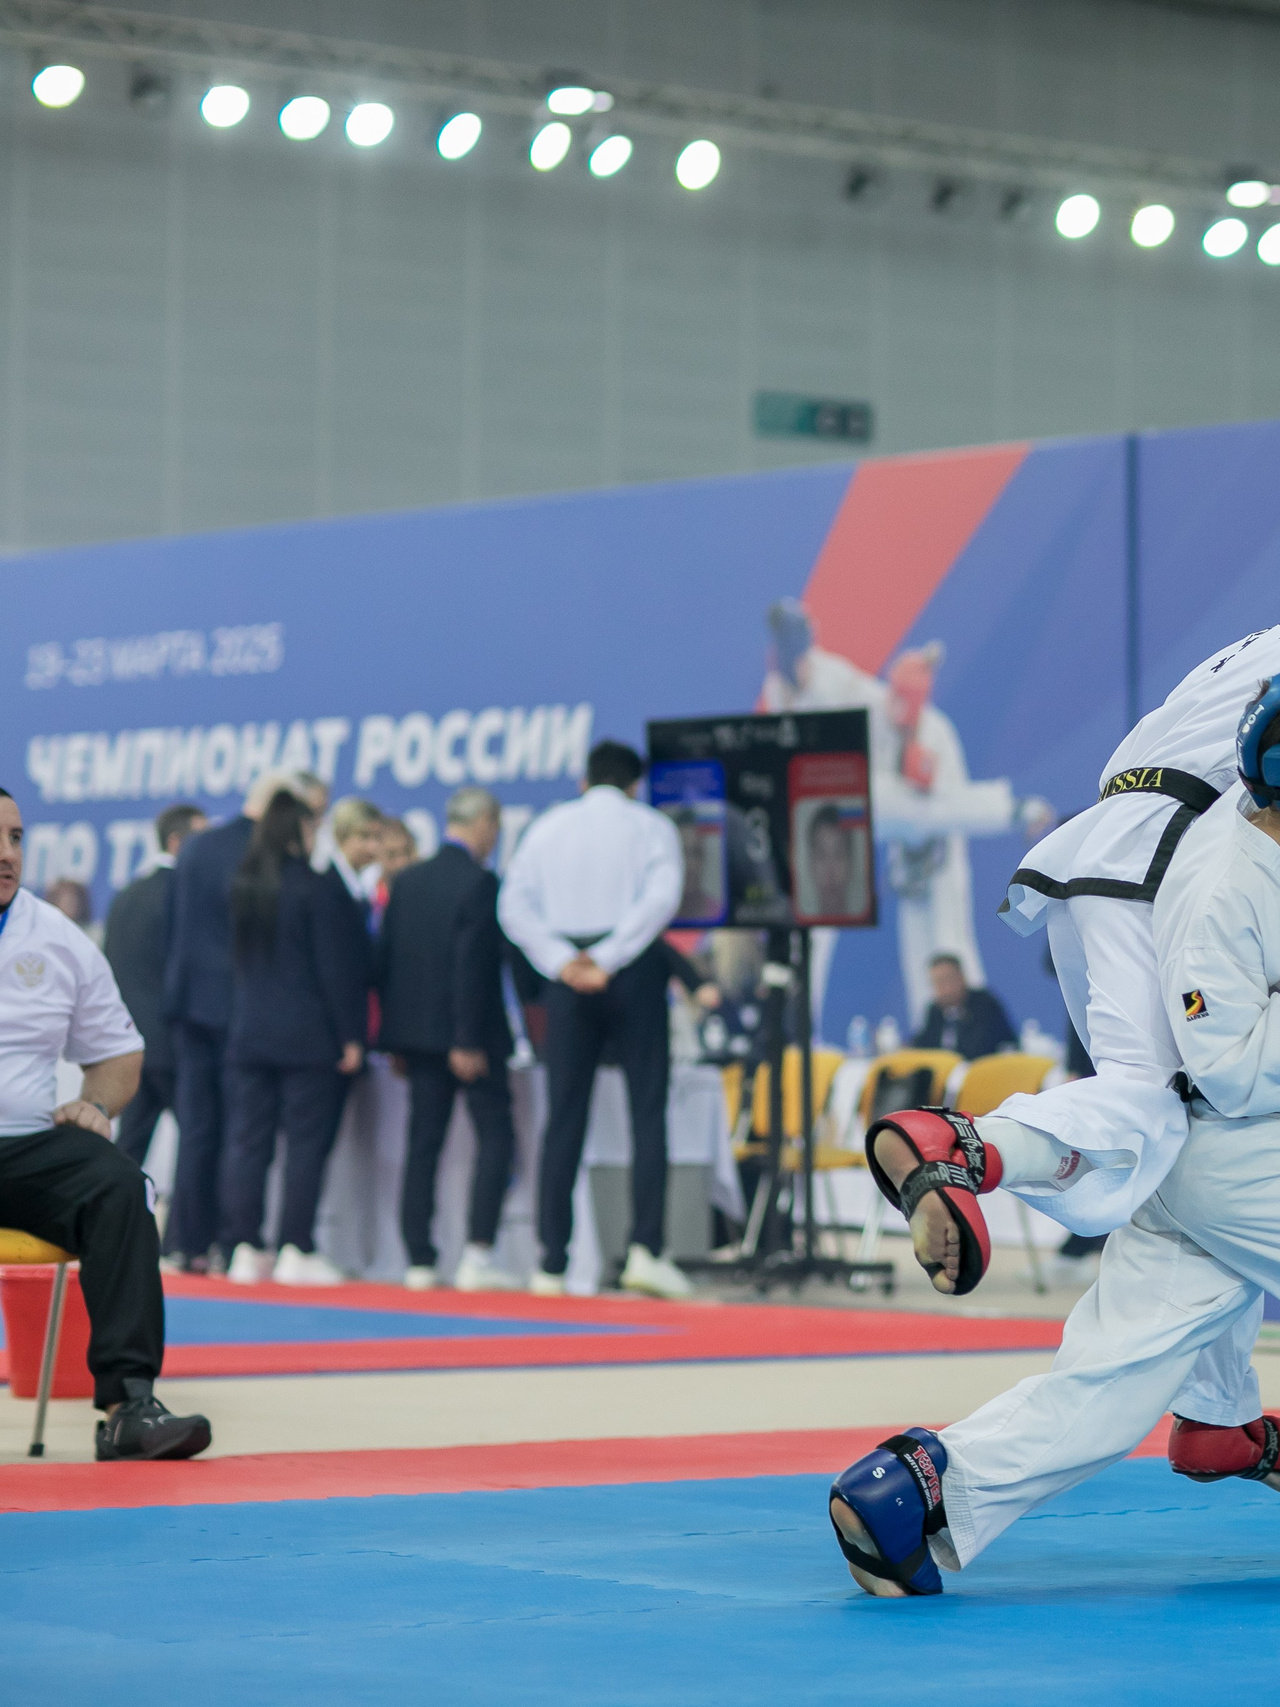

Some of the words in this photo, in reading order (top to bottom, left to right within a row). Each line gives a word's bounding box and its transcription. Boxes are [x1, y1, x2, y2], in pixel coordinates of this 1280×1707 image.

[27, 717, 349, 803] ЧЕМПИОНАТ
[354, 702, 595, 789] РОССИИ
[872, 1466, 886, 1479] S
